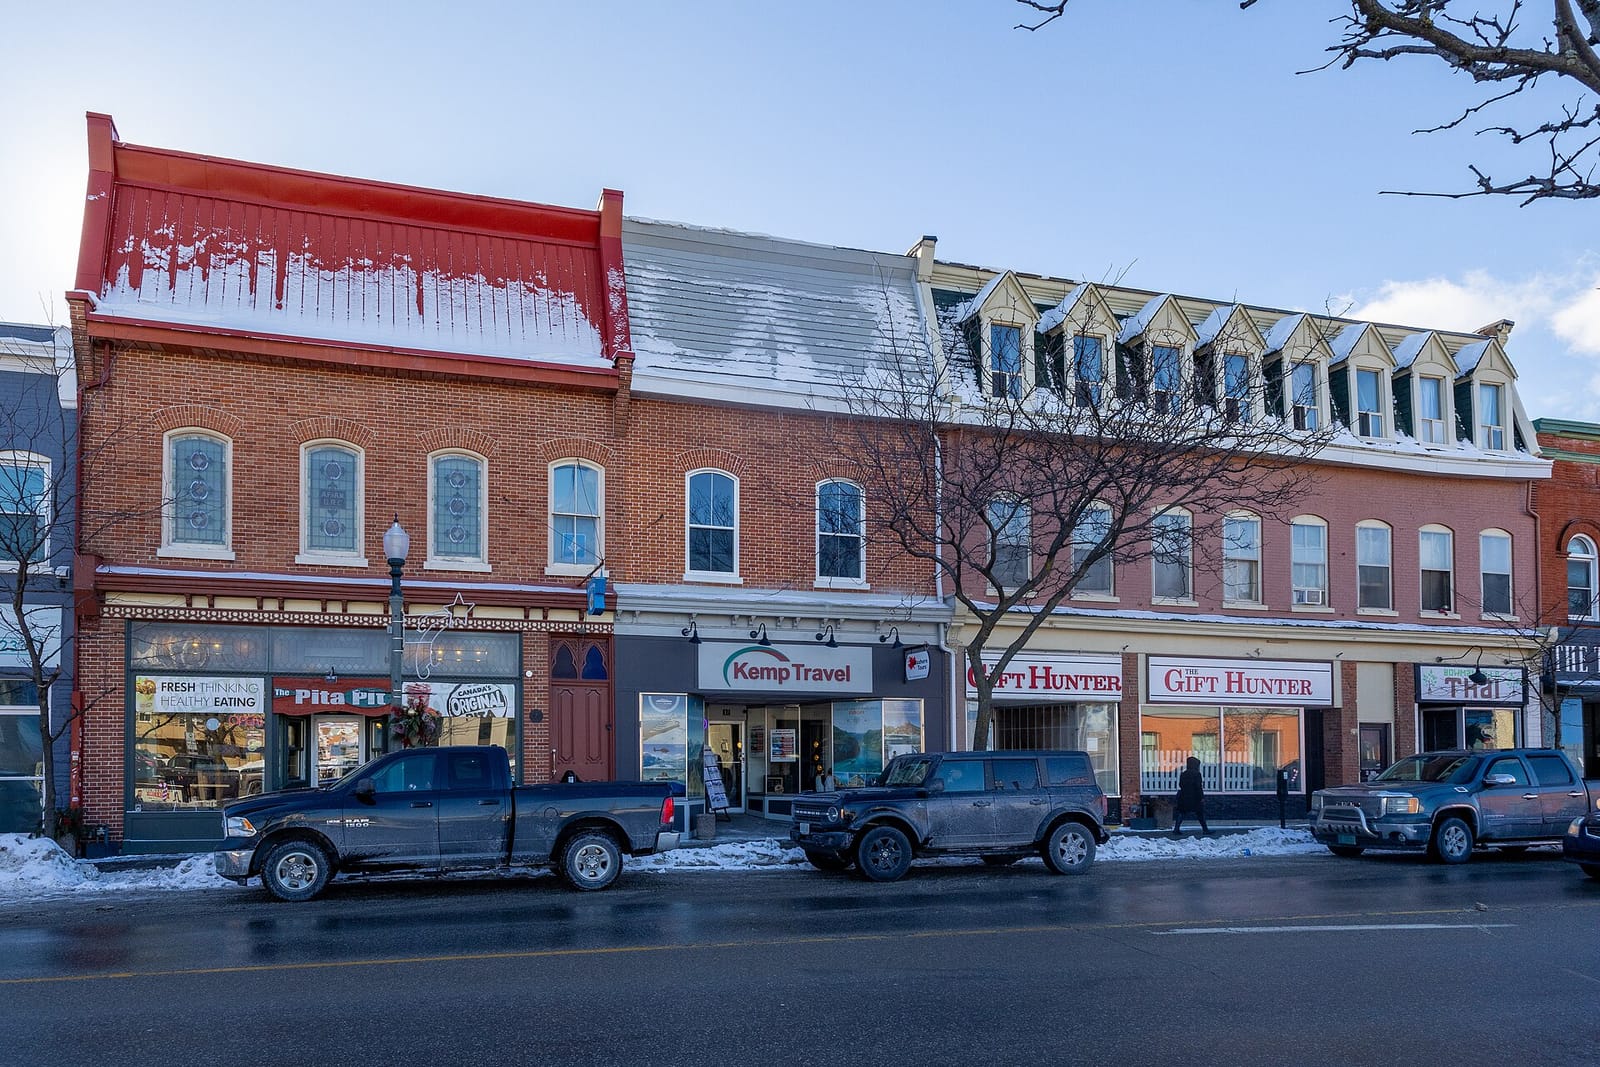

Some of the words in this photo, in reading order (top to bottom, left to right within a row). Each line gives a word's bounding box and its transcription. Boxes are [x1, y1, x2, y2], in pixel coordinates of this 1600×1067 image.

[1552, 645, 1588, 672] THE
[734, 662, 790, 684] Kemp
[792, 664, 851, 682] Travel
[1028, 666, 1122, 691] HUNTER
[1164, 668, 1219, 693] GIFT
[1224, 671, 1313, 695] HUNTER
[161, 682, 196, 692] FRESH
[200, 682, 259, 693] THINKING
[274, 688, 290, 696] The
[295, 689, 346, 704] Pita
[458, 685, 492, 696] CANADA'S
[161, 696, 210, 707] HEALTHY
[214, 697, 256, 707] EATING
[450, 689, 506, 717] ORIGINAL
